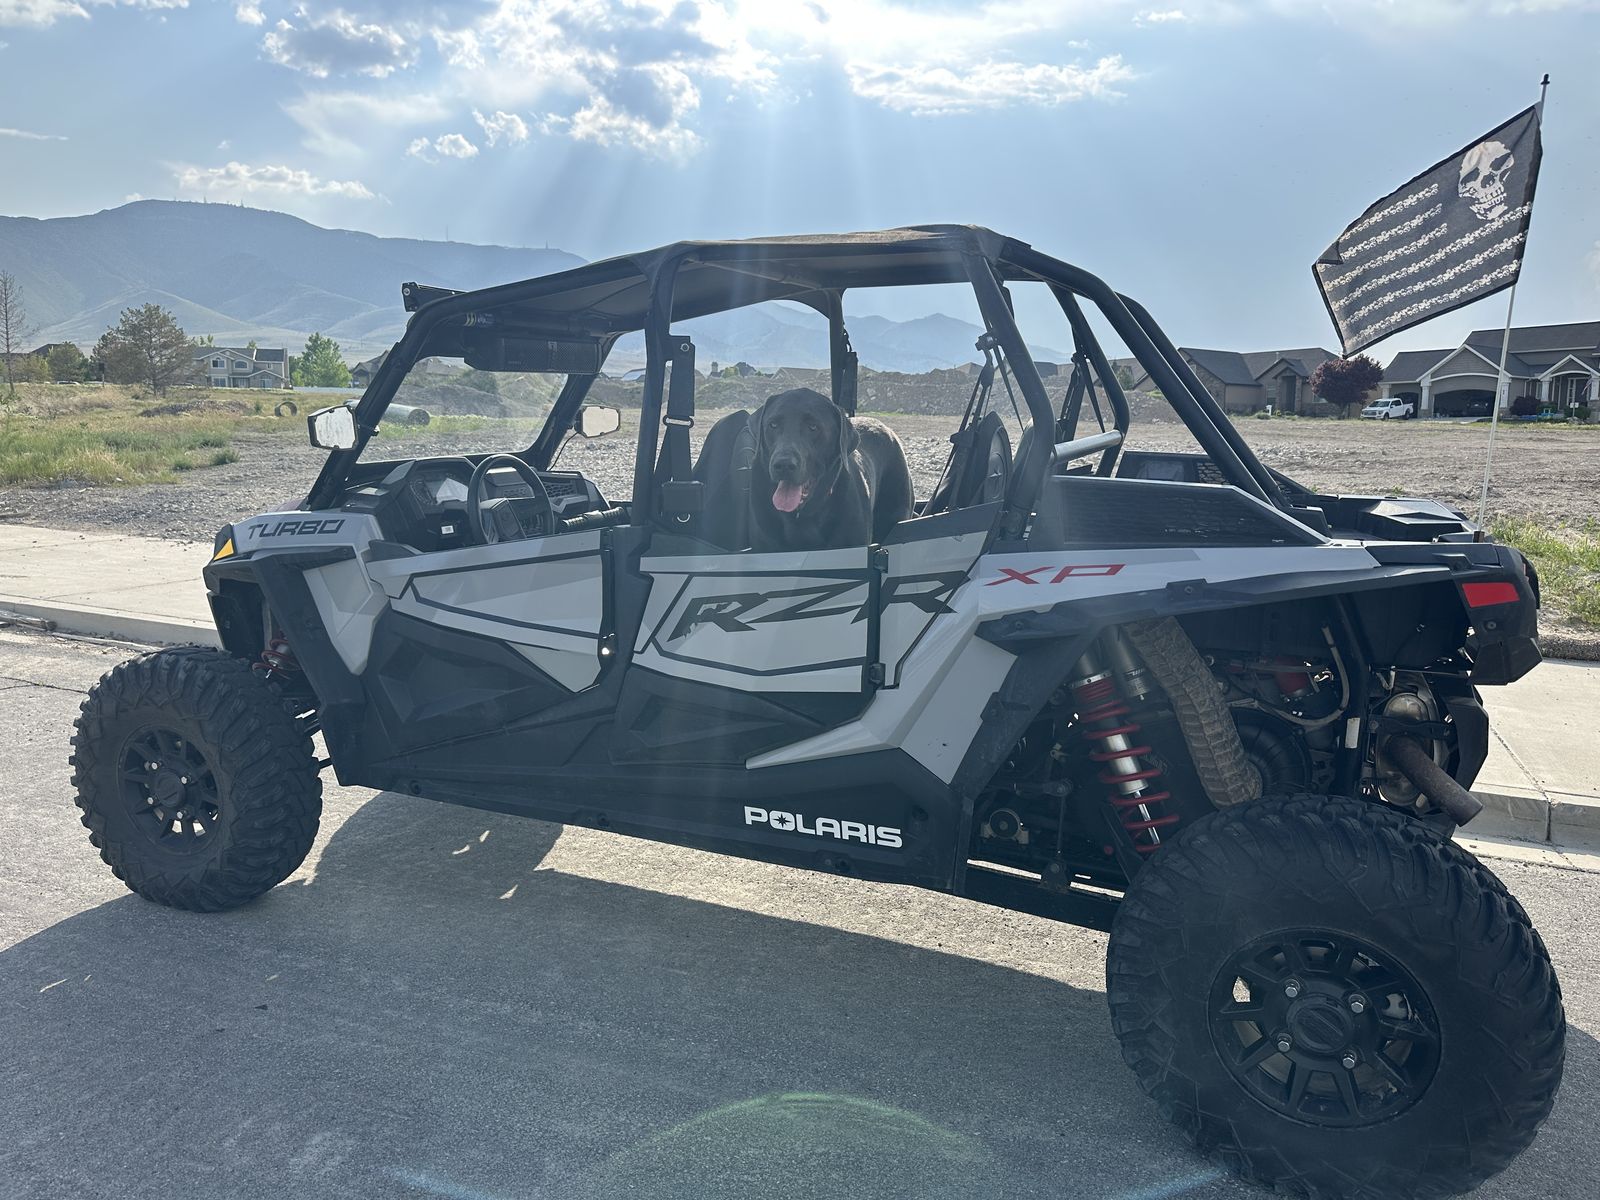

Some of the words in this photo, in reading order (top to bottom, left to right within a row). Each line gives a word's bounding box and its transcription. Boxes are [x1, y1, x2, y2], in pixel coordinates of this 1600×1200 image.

[248, 519, 346, 540] TURBO
[983, 564, 1126, 586] XP
[667, 570, 971, 642] RZR
[744, 806, 903, 848] POLARIS
